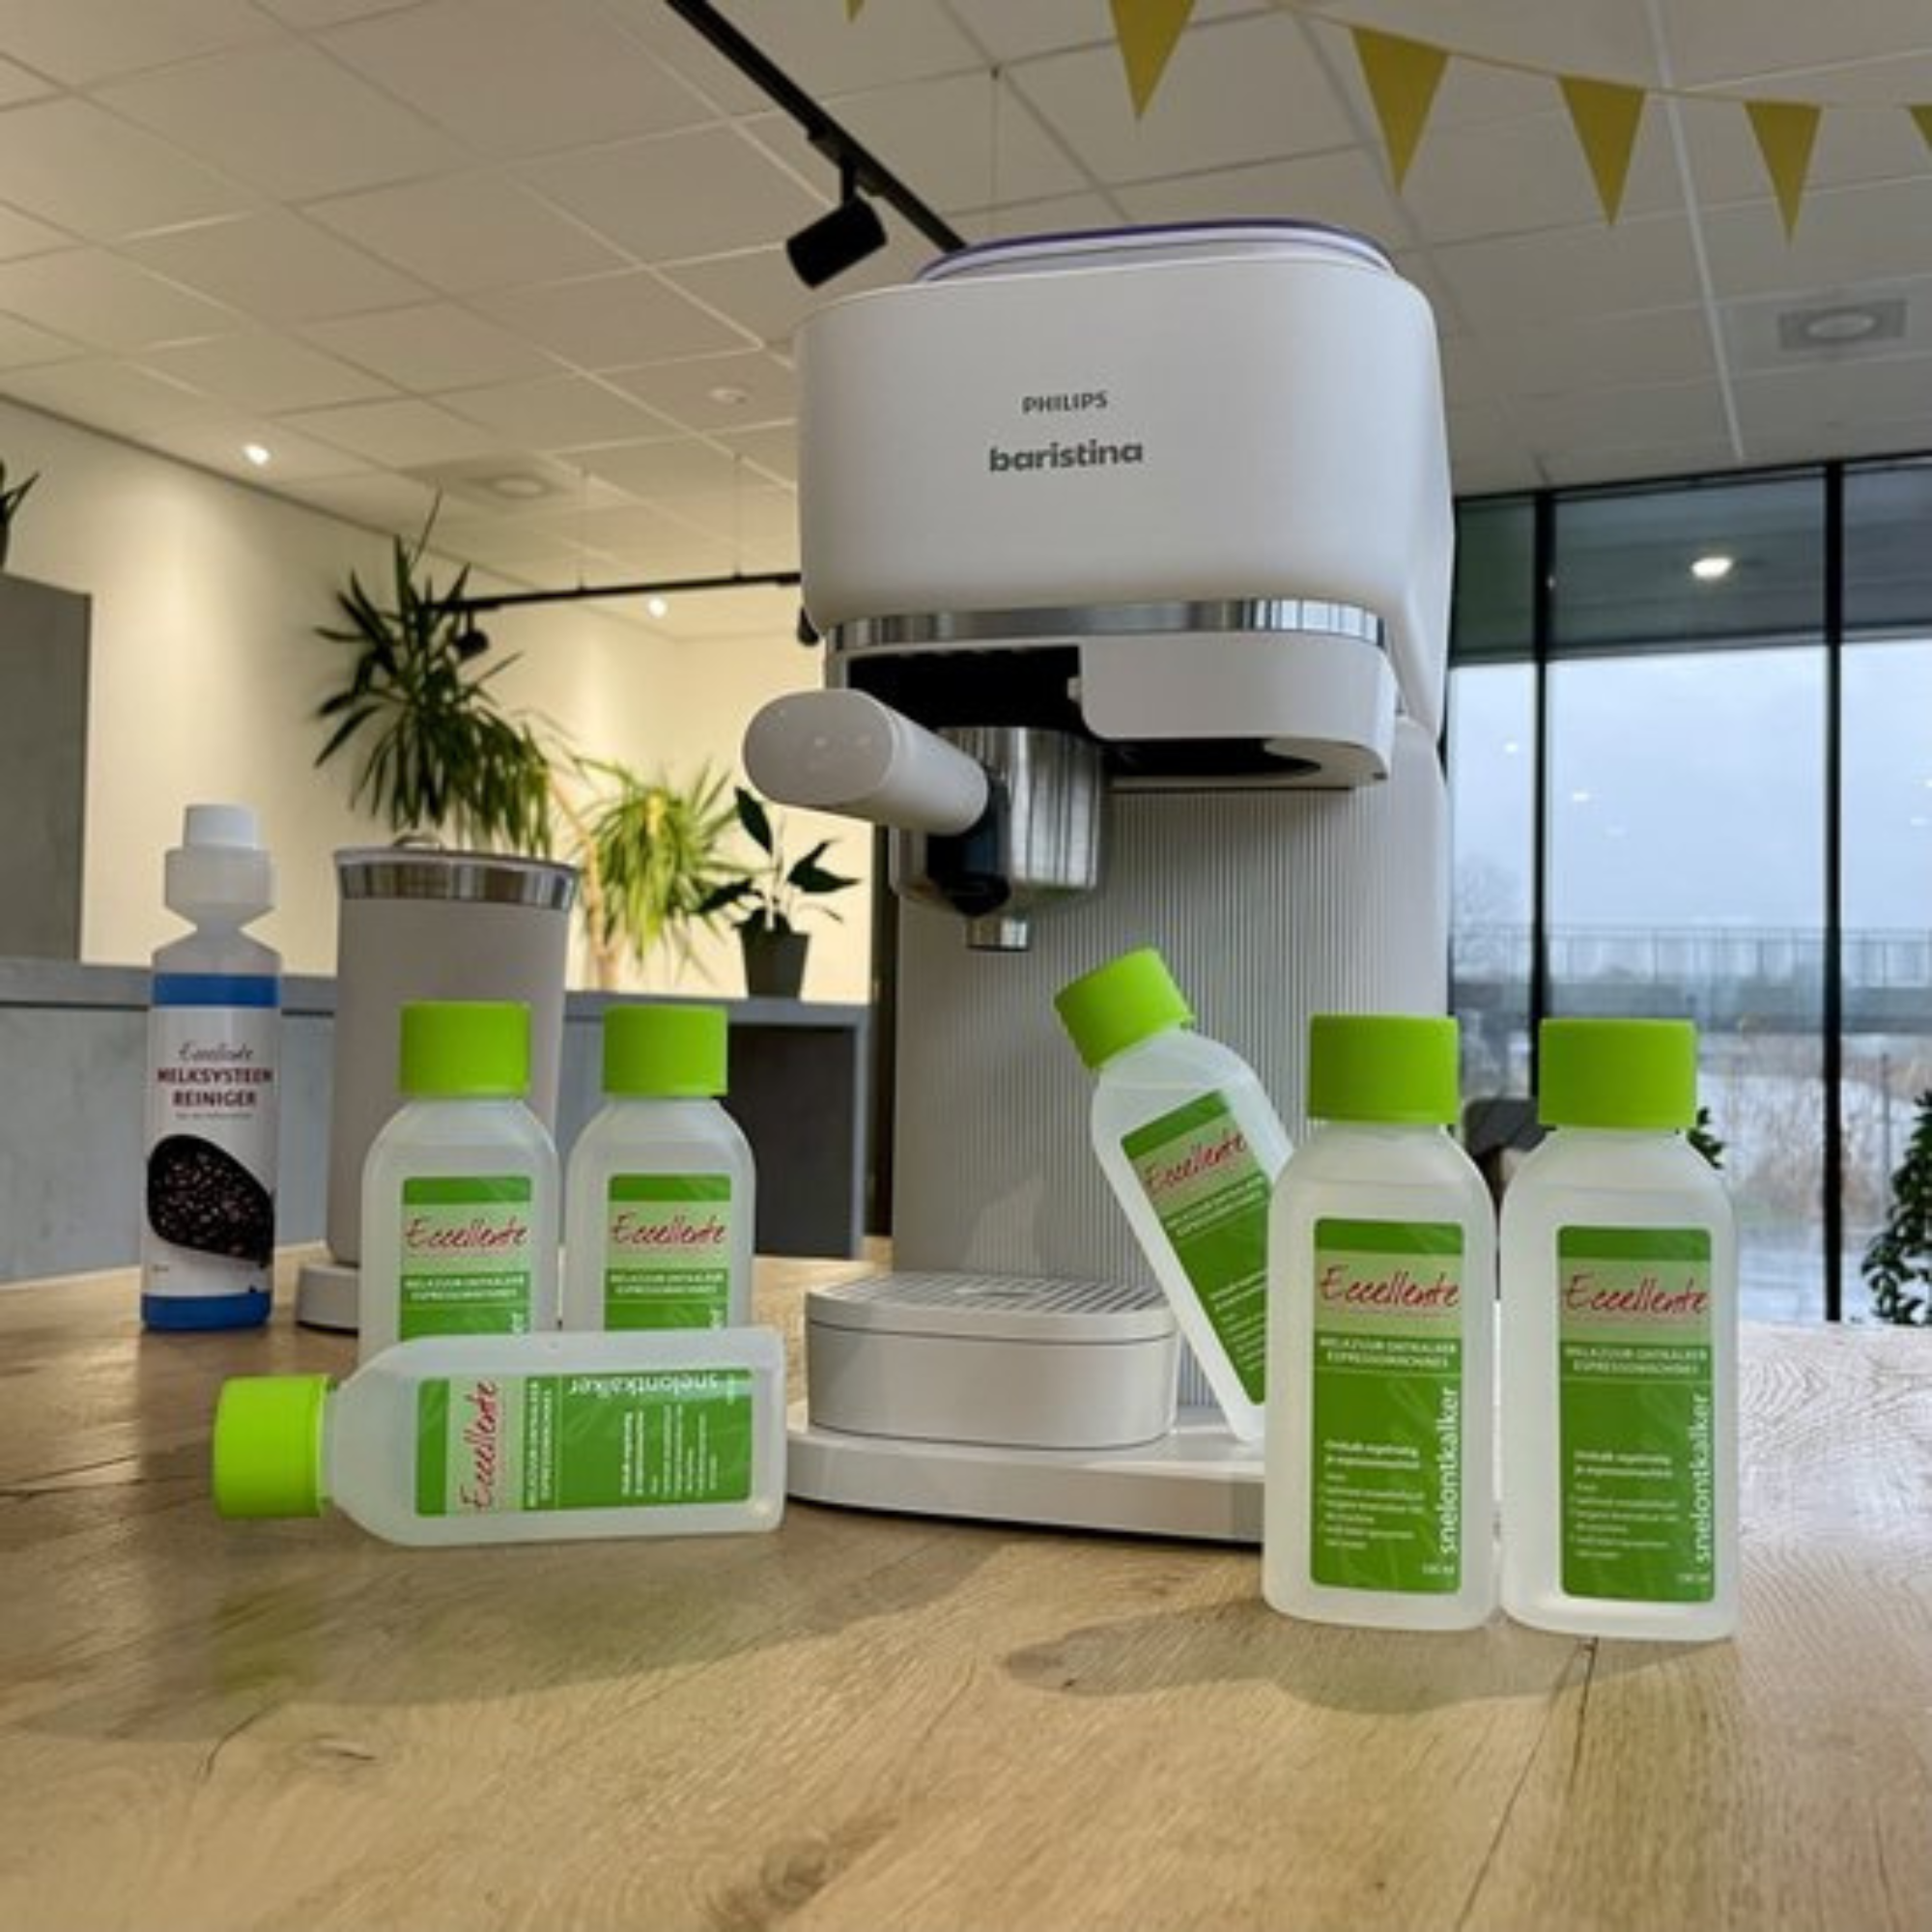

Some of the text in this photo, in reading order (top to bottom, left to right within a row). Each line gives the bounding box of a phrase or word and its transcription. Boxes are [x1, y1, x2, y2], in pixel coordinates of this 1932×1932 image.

[1022, 391, 1108, 413] PHILIPS
[990, 439, 1142, 471] baristina
[174, 1091, 255, 1106] REINIGER
[405, 1214, 527, 1248] Eccellente
[611, 1213, 725, 1246] Eccellente
[1320, 1264, 1459, 1307] Eccellente
[1561, 1274, 1708, 1315] Eccellente
[568, 1373, 718, 1398] snelontkalker
[460, 1379, 497, 1509] Eccellente
[1436, 1387, 1458, 1553] snelontkalker
[1689, 1392, 1711, 1563] snelontkalker
